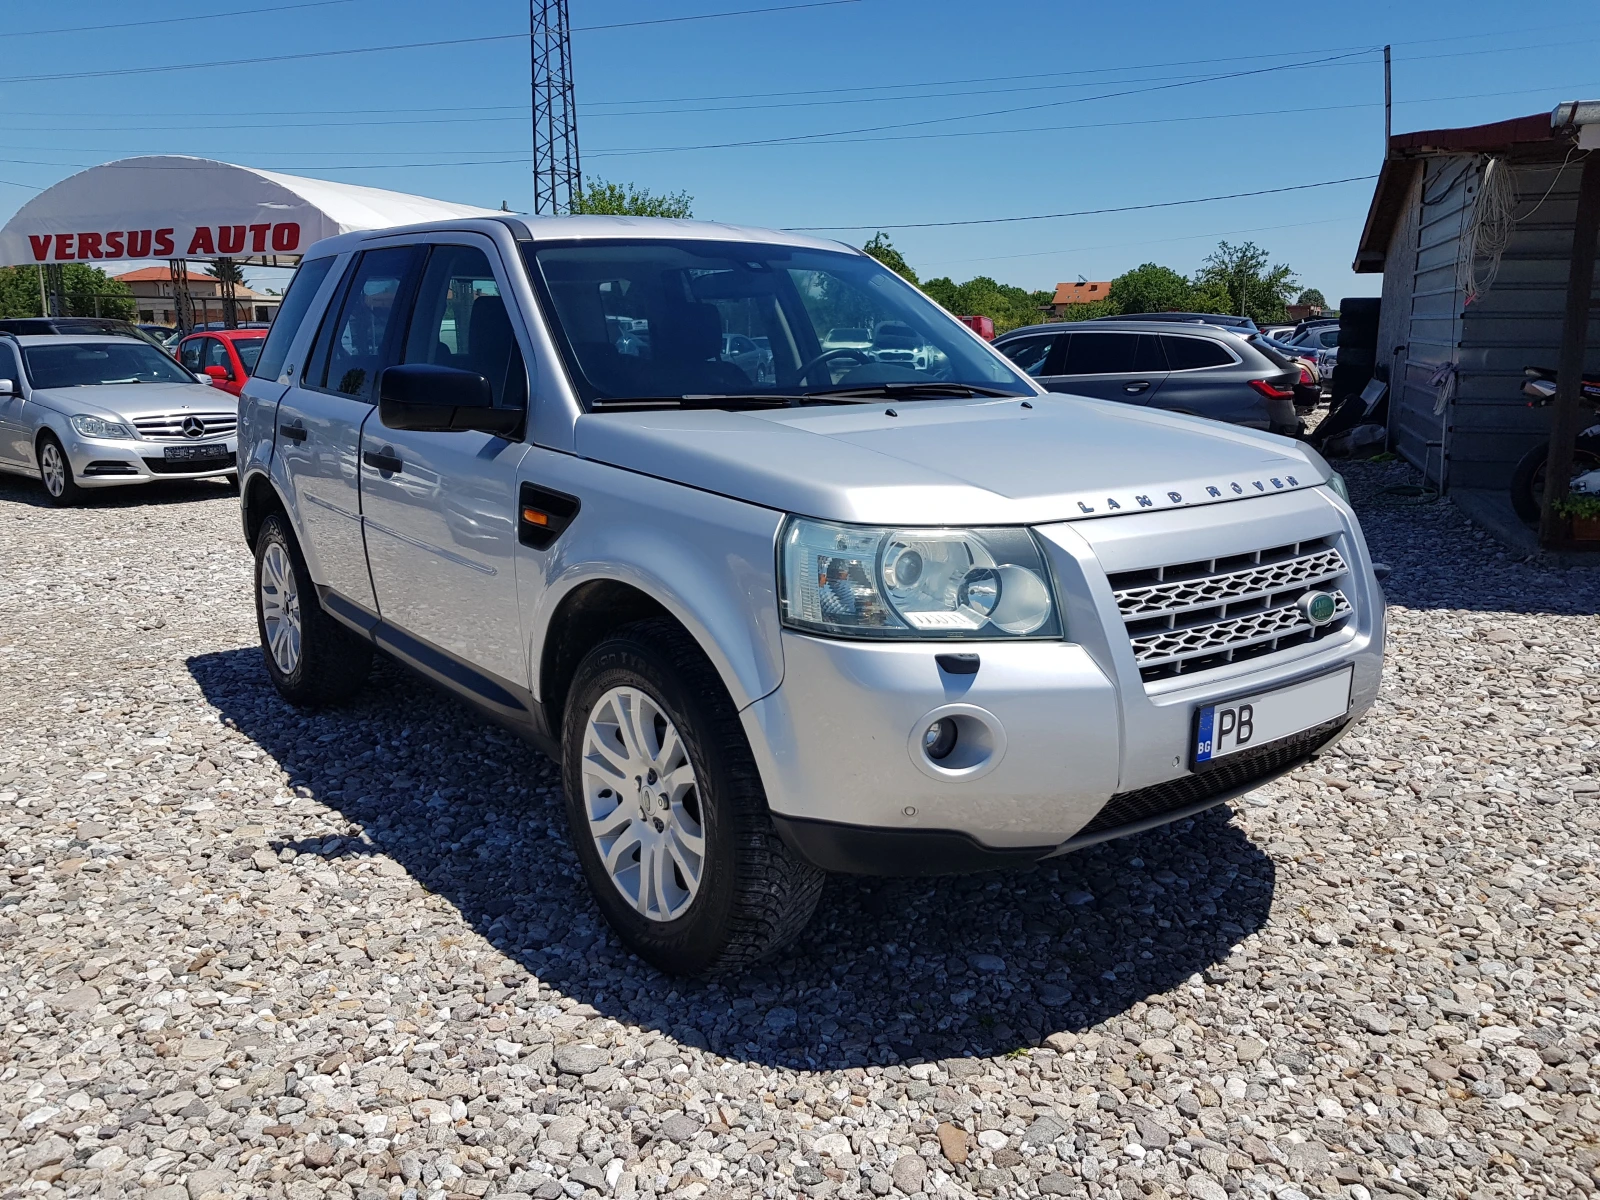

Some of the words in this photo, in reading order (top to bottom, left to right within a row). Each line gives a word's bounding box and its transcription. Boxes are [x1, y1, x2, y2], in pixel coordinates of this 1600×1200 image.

[28, 228, 174, 261] VERSUS
[187, 222, 301, 254] AUTO
[1077, 491, 1182, 513] LAND
[1206, 475, 1299, 498] ROVER
[1217, 704, 1253, 750] PB
[1197, 740, 1211, 755] BG
